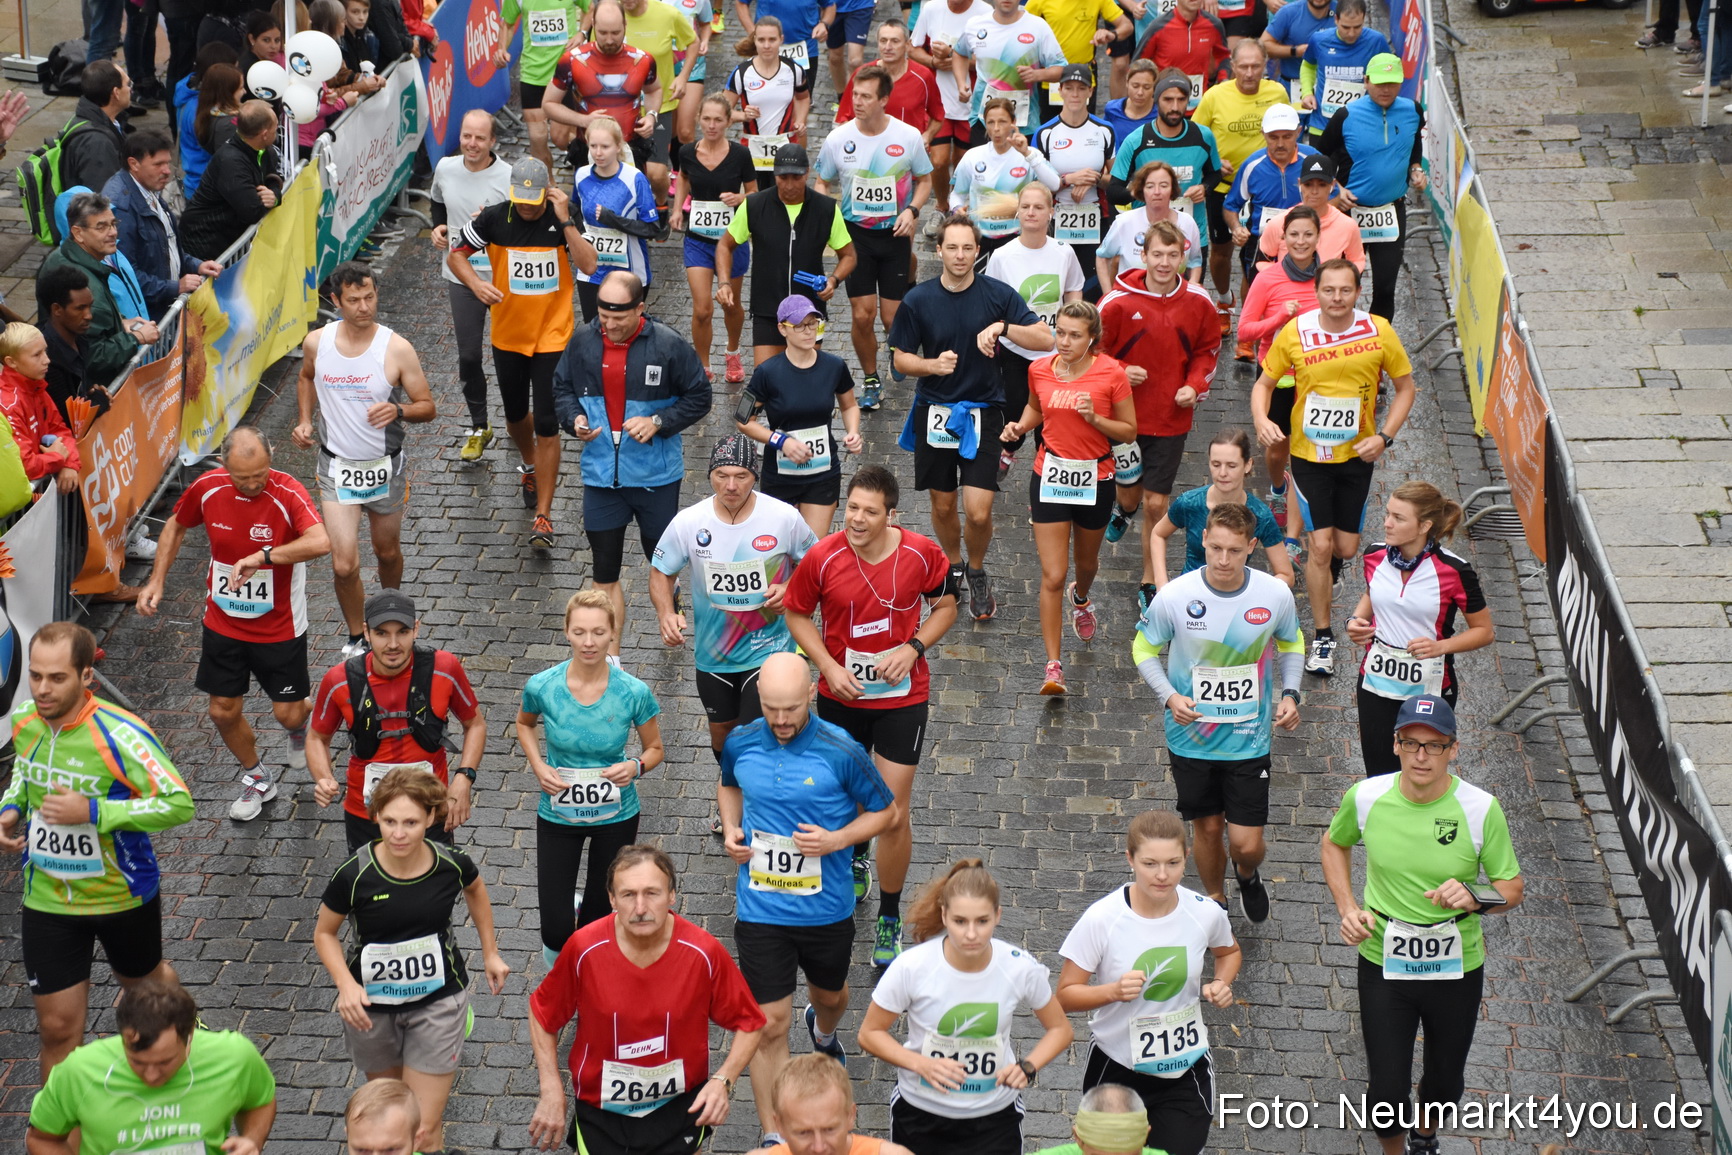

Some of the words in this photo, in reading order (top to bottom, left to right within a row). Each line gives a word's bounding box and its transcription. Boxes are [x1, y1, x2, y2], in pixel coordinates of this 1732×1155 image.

[532, 18, 565, 33] 2553
[466, 6, 500, 70] Hervis
[1325, 66, 1364, 75] HUBER
[428, 60, 452, 128] Hervis
[856, 186, 892, 202] 2493
[695, 210, 731, 226] 2875
[1060, 213, 1096, 228] 2218
[1356, 211, 1394, 228] 2308
[514, 262, 555, 278] 2810
[1304, 350, 1338, 366] MAX
[1344, 342, 1382, 357] BÖGL
[322, 374, 371, 384] NeproSport
[1310, 408, 1354, 427] 2728
[1316, 431, 1345, 440] Andreas
[342, 468, 388, 487] 2899
[1048, 467, 1092, 487] 2802
[351, 490, 376, 498] Markus
[1052, 488, 1084, 498] Veronika
[755, 539, 775, 547] Hervis
[712, 571, 762, 593] 2398
[229, 601, 255, 611] Rudolf
[728, 596, 749, 604] Klaus
[1248, 612, 1268, 620] Hervis
[862, 624, 879, 633] DEHN
[1370, 654, 1422, 684] 3006
[1200, 678, 1253, 702] 2452
[1216, 707, 1238, 716] Timo
[108, 722, 186, 796] BOCK
[17, 755, 103, 796] BOCK
[558, 781, 614, 804] 2662
[574, 809, 599, 818] Tanja
[1438, 826, 1446, 836] F
[1445, 833, 1452, 842] C
[36, 827, 94, 856] 2846
[43, 859, 88, 871] Johannes
[764, 849, 806, 873] 197
[766, 877, 804, 888] Andreas
[1392, 936, 1456, 960] 2097
[370, 953, 436, 982] 2309
[1405, 963, 1441, 973] Ludwig
[382, 985, 428, 996] Christine
[1166, 1007, 1196, 1024] BOCK
[1140, 1020, 1199, 1058] 2135
[630, 1044, 652, 1054] DEHN
[1157, 1058, 1190, 1072] Carina
[610, 1077, 678, 1102] 2644
[140, 1104, 181, 1122] JONI
[117, 1129, 127, 1144] #
